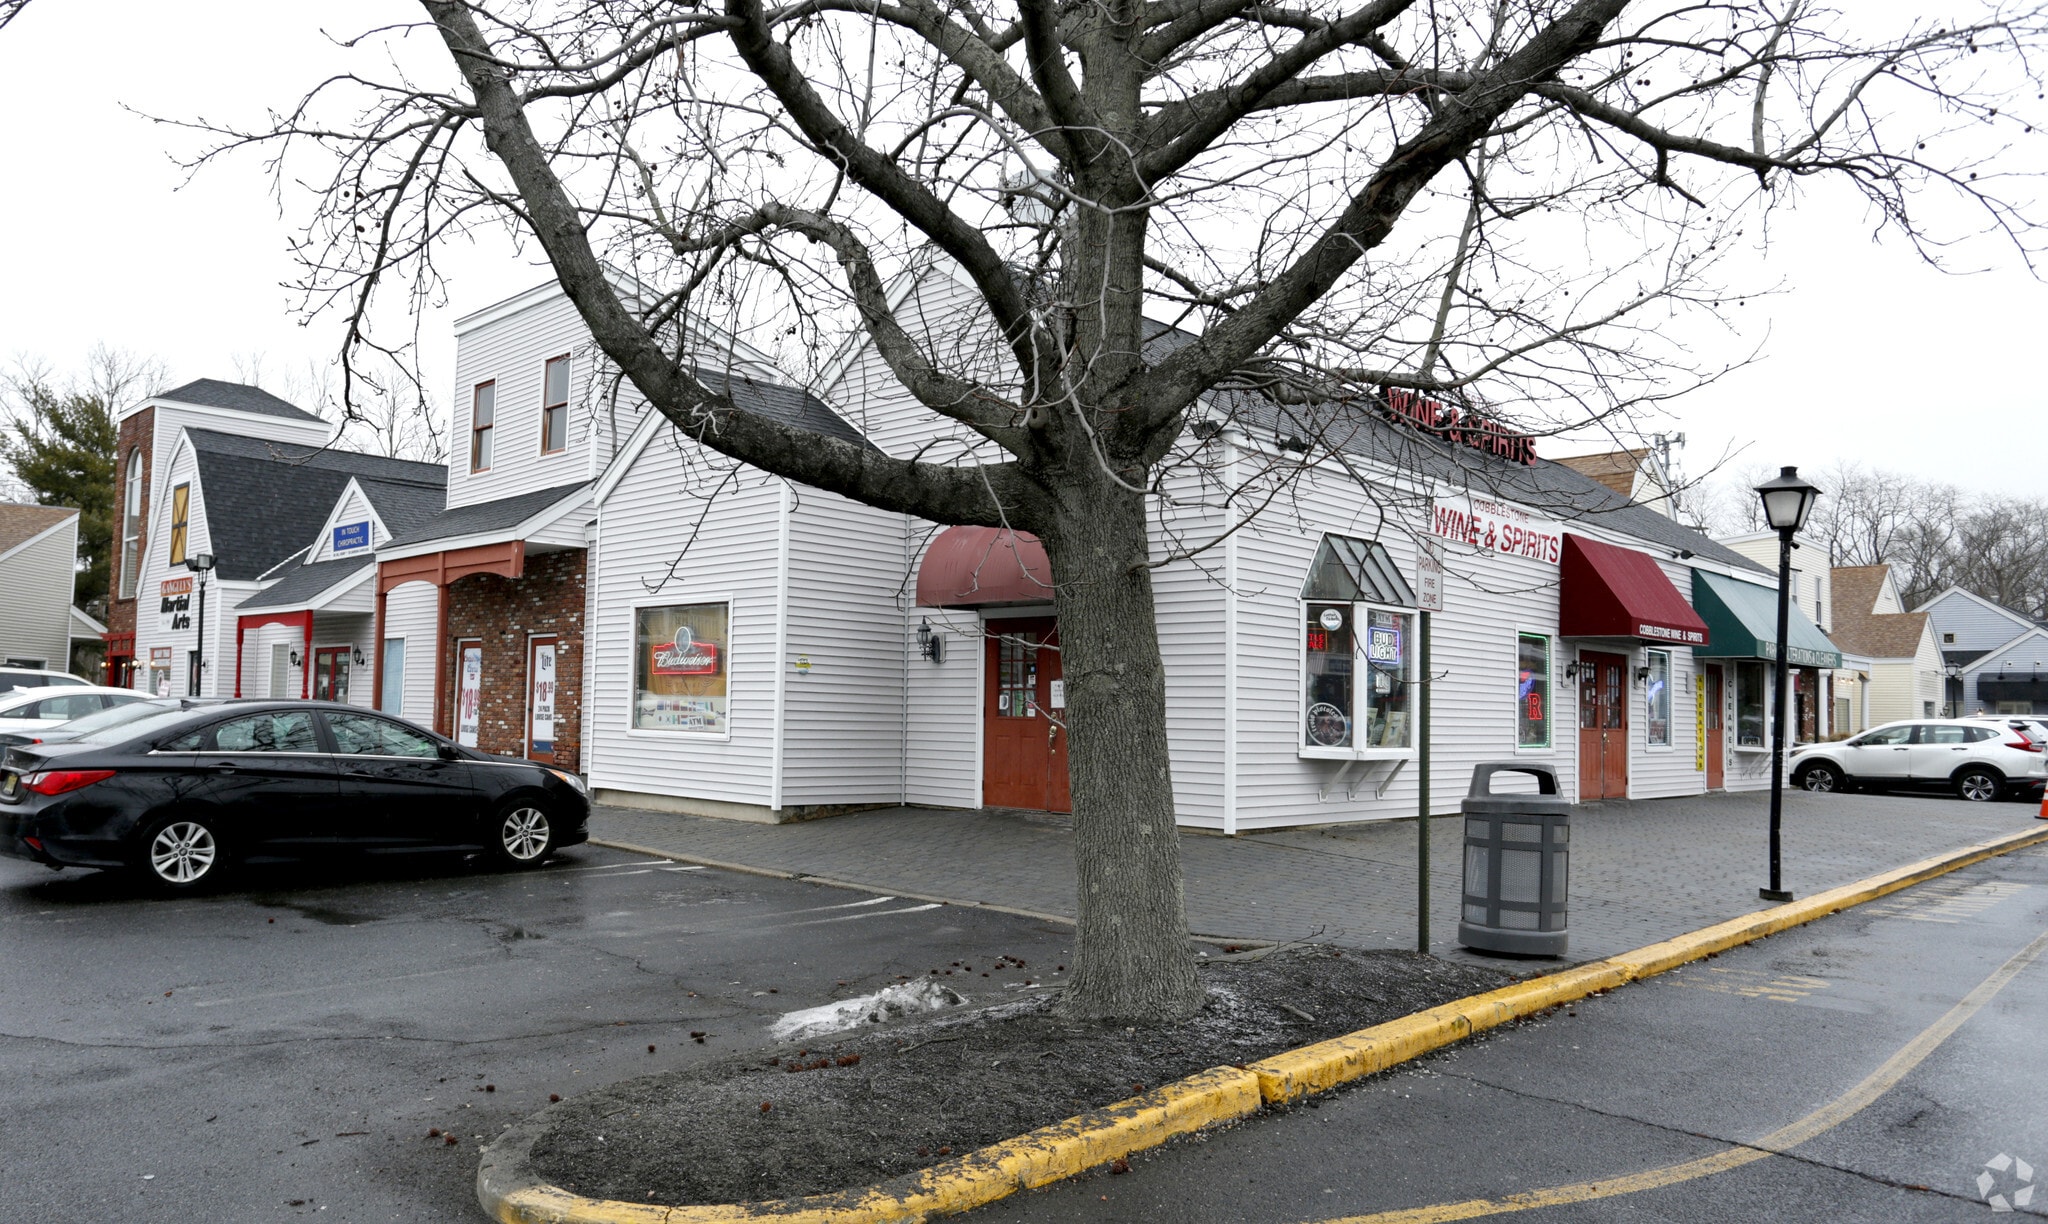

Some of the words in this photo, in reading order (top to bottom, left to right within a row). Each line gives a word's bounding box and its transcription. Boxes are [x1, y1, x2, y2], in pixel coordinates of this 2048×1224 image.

[1387, 387, 1443, 435] WINE
[1450, 408, 1462, 443] &
[1468, 414, 1537, 466] SPIRITS
[1473, 499, 1529, 524] COBBLESTONE
[1434, 505, 1482, 545] WINE
[1484, 521, 1497, 549] &
[1500, 524, 1559, 563] SPIRITS
[1419, 556, 1441, 574] PARKING
[1424, 577, 1435, 589] FIRE
[161, 594, 190, 613] Martial
[1423, 592, 1437, 604] ZONE
[172, 613, 190, 630] Arts
[1373, 631, 1394, 646] BUD
[1639, 624, 1671, 638] COBBLESTONE
[1670, 629, 1681, 640] WINE
[1687, 632, 1703, 643] SPIRITS
[654, 651, 713, 667] Budweiser
[1370, 644, 1397, 660] LIGHT
[1787, 647, 1813, 663] LTERATIONS
[540, 653, 552, 670] Lite
